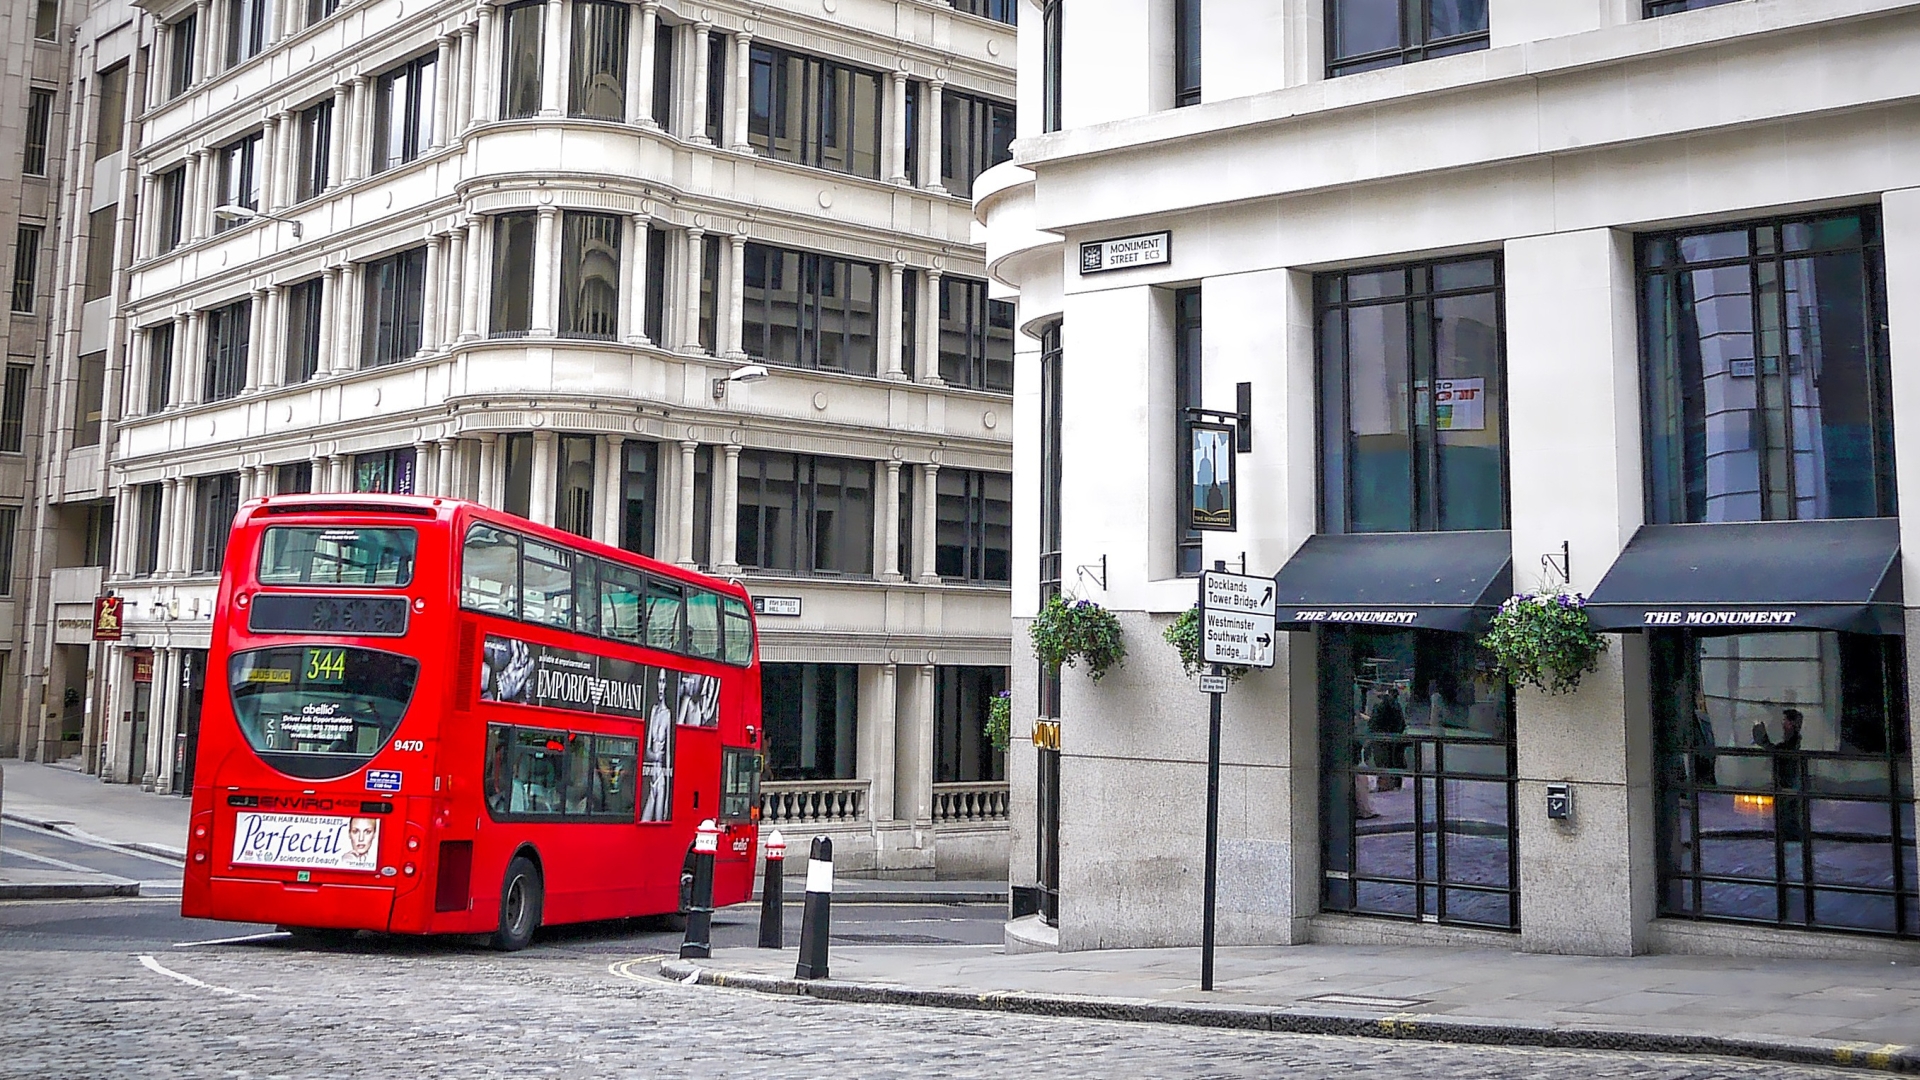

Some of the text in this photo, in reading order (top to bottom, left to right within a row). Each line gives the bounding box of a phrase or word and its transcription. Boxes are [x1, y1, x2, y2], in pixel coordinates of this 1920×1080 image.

[1110, 238, 1160, 254] MONUMENT
[1110, 250, 1160, 265] STREET EC3
[1208, 578, 1247, 593] Docklands
[1208, 591, 1258, 609] Tower Bridge
[1208, 615, 1255, 631] Westminster
[1295, 611, 1417, 624] THE MONUMENT
[1643, 611, 1796, 624] THE MONUMENT
[1208, 630, 1248, 644] Southwark
[1215, 644, 1240, 658] Bridge
[307, 650, 345, 680] 344
[536, 669, 642, 710] EMPORIO ARMANI
[302, 704, 334, 715] abellio
[313, 716, 352, 724] Opportunities
[394, 740, 424, 751] 9470
[260, 796, 333, 810] ENVIRO
[300, 816, 318, 824] NAILS
[236, 815, 347, 862] Perfectil
[280, 855, 305, 863] science
[315, 857, 339, 866] beauty
